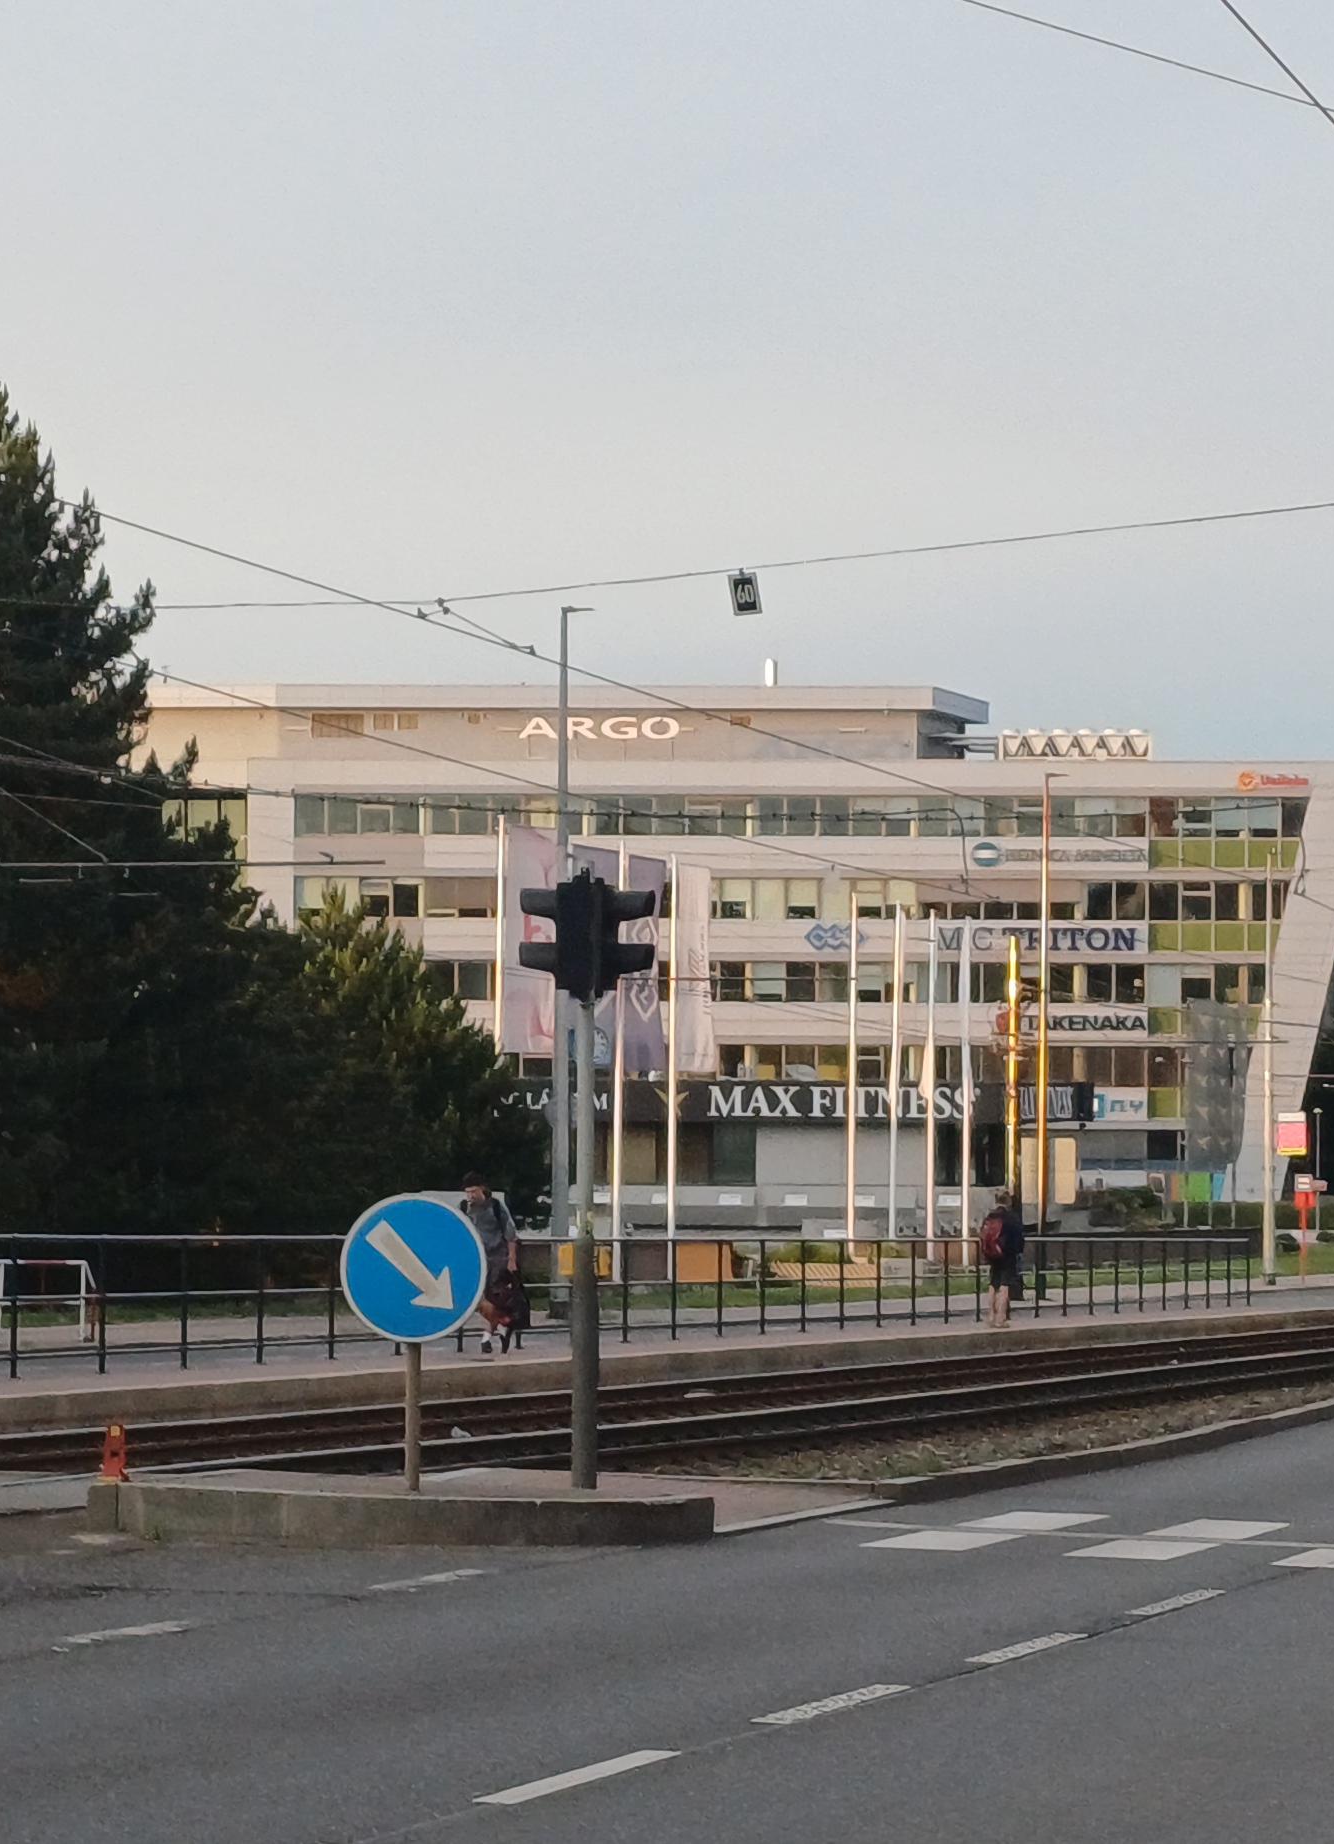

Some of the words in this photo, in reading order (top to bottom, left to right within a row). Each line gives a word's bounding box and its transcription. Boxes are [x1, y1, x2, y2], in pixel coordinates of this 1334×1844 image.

[736, 583, 756, 604] 60
[518, 715, 680, 741] ARGO
[706, 1084, 802, 1118] MAX
